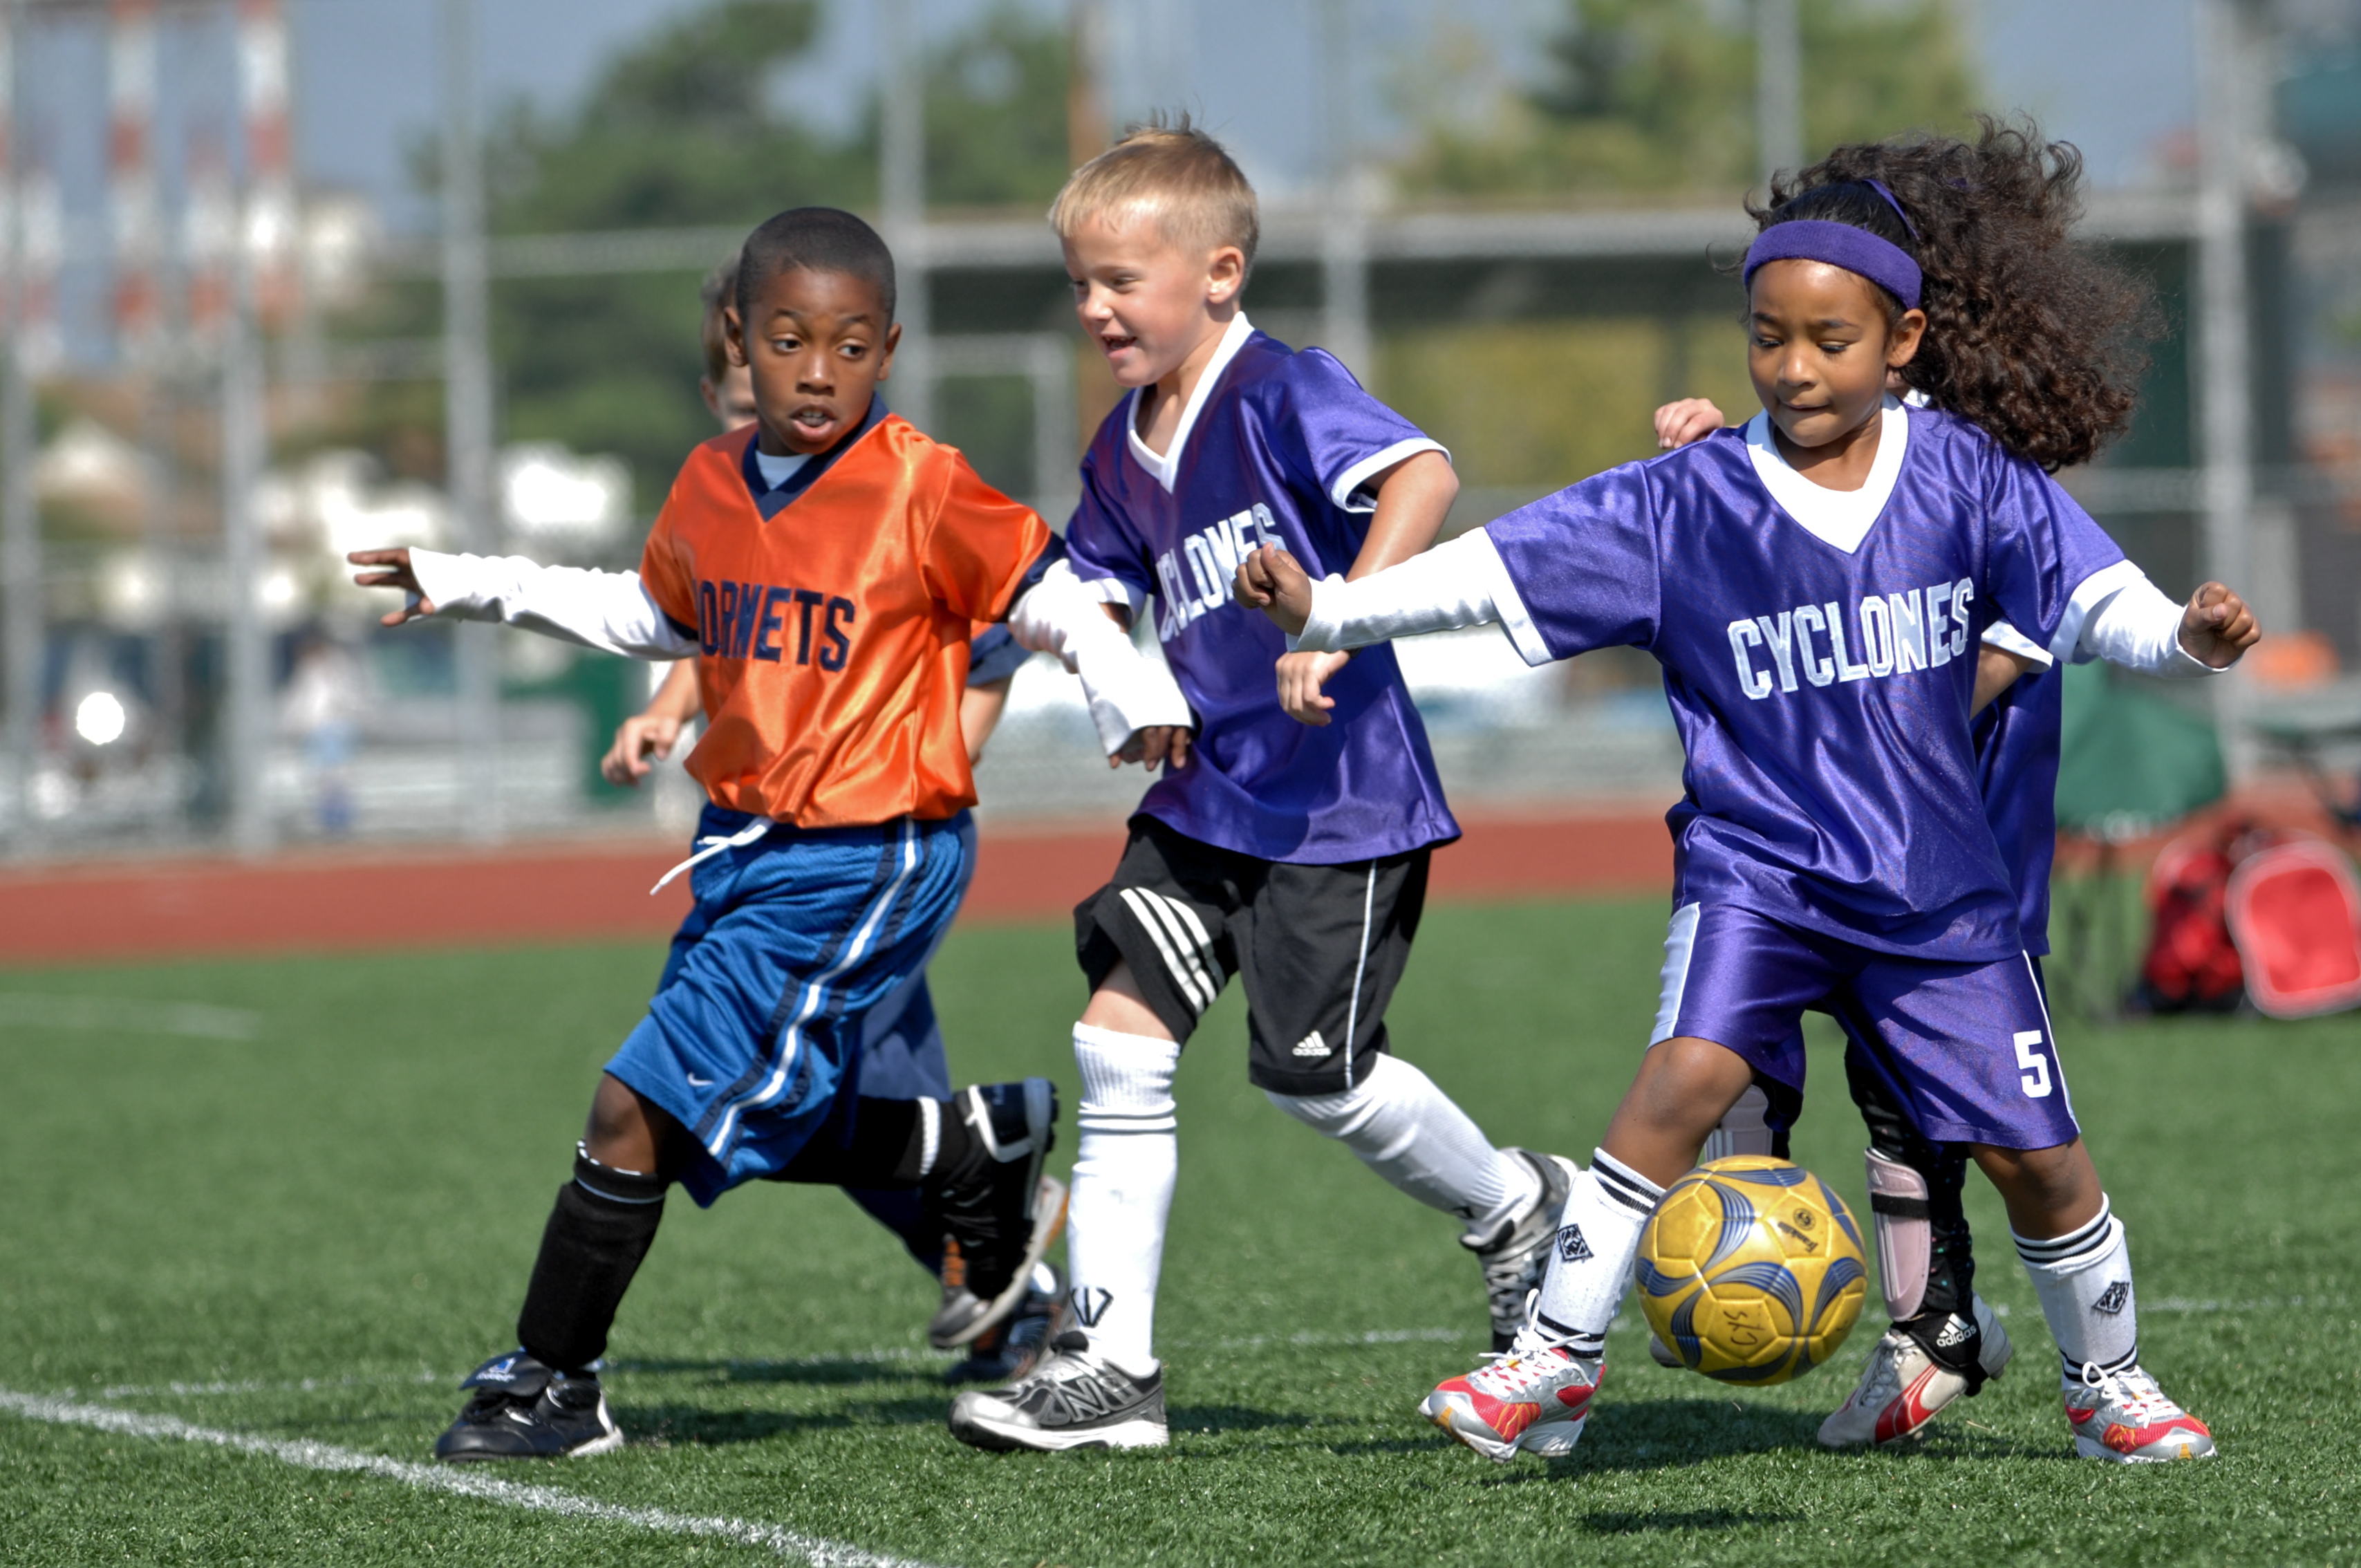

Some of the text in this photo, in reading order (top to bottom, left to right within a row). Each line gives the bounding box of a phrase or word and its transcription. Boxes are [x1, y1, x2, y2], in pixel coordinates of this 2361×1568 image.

[693, 579, 855, 672] ORNETS
[1728, 577, 1974, 700] CYCLONES
[2013, 1029, 2053, 1098] 5
[1936, 1325, 1977, 1347] adidas
